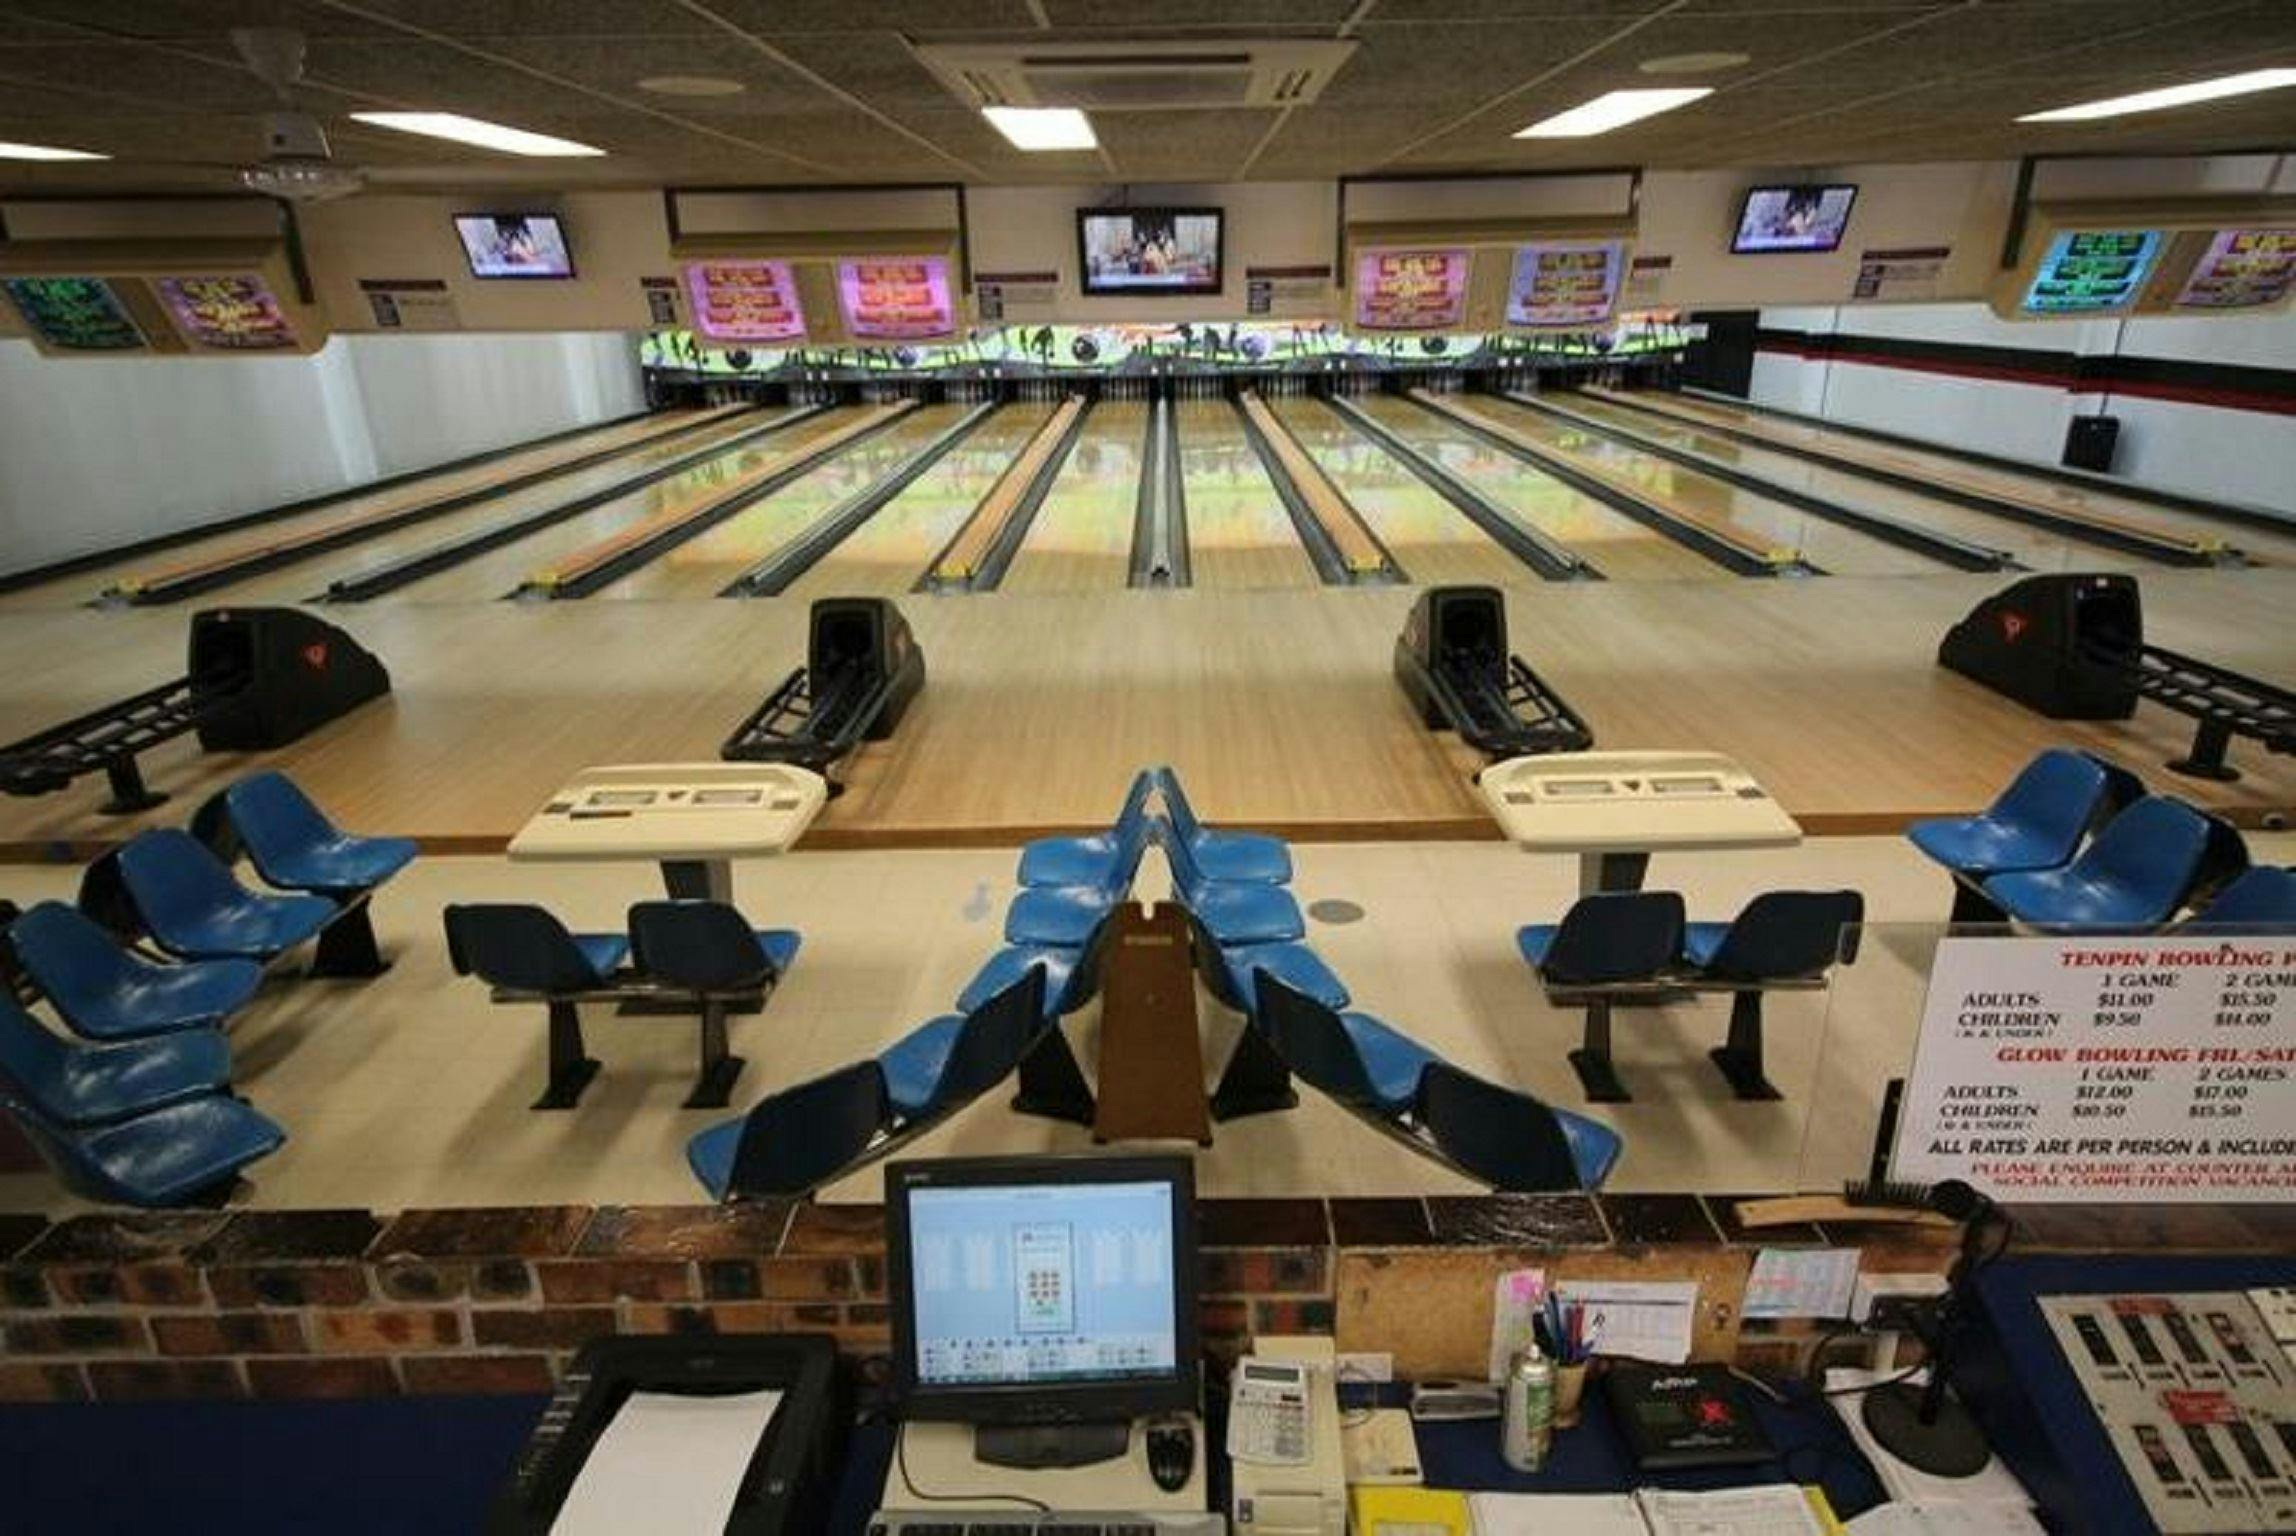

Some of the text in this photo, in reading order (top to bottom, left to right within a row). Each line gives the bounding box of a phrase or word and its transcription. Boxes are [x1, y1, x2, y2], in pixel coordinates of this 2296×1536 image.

[2061, 951, 2149, 967] TENPIN
[2157, 951, 2273, 967] BOWLING
[2103, 973, 2111, 987] 1
[2118, 973, 2180, 987] GAME
[2225, 973, 2239, 988] 2
[1962, 993, 2040, 1007] ADULTS
[1958, 1012, 2060, 1027] CHILDREN
[1997, 1048, 2067, 1062] GLOW
[2076, 1048, 2190, 1062] BOWLING
[2082, 1067, 2286, 1081] 1 GAME 2 GAMES
[1944, 1085, 2019, 1099] ADULTS
[1940, 1103, 2040, 1118] CHILDREN
[1928, 1138, 1963, 1154] ALL
[1969, 1138, 2029, 1154] RATES
[2034, 1139, 2073, 1154] ARE
[2077, 1139, 2113, 1154] PER
[2118, 1139, 2193, 1154] PERSON
[2197, 1139, 2210, 1155] &
[1971, 1161, 2040, 1174] PLEASE
[2049, 1161, 2132, 1174] ENQUIRE
[2177, 1161, 2270, 1174] COUNTER
